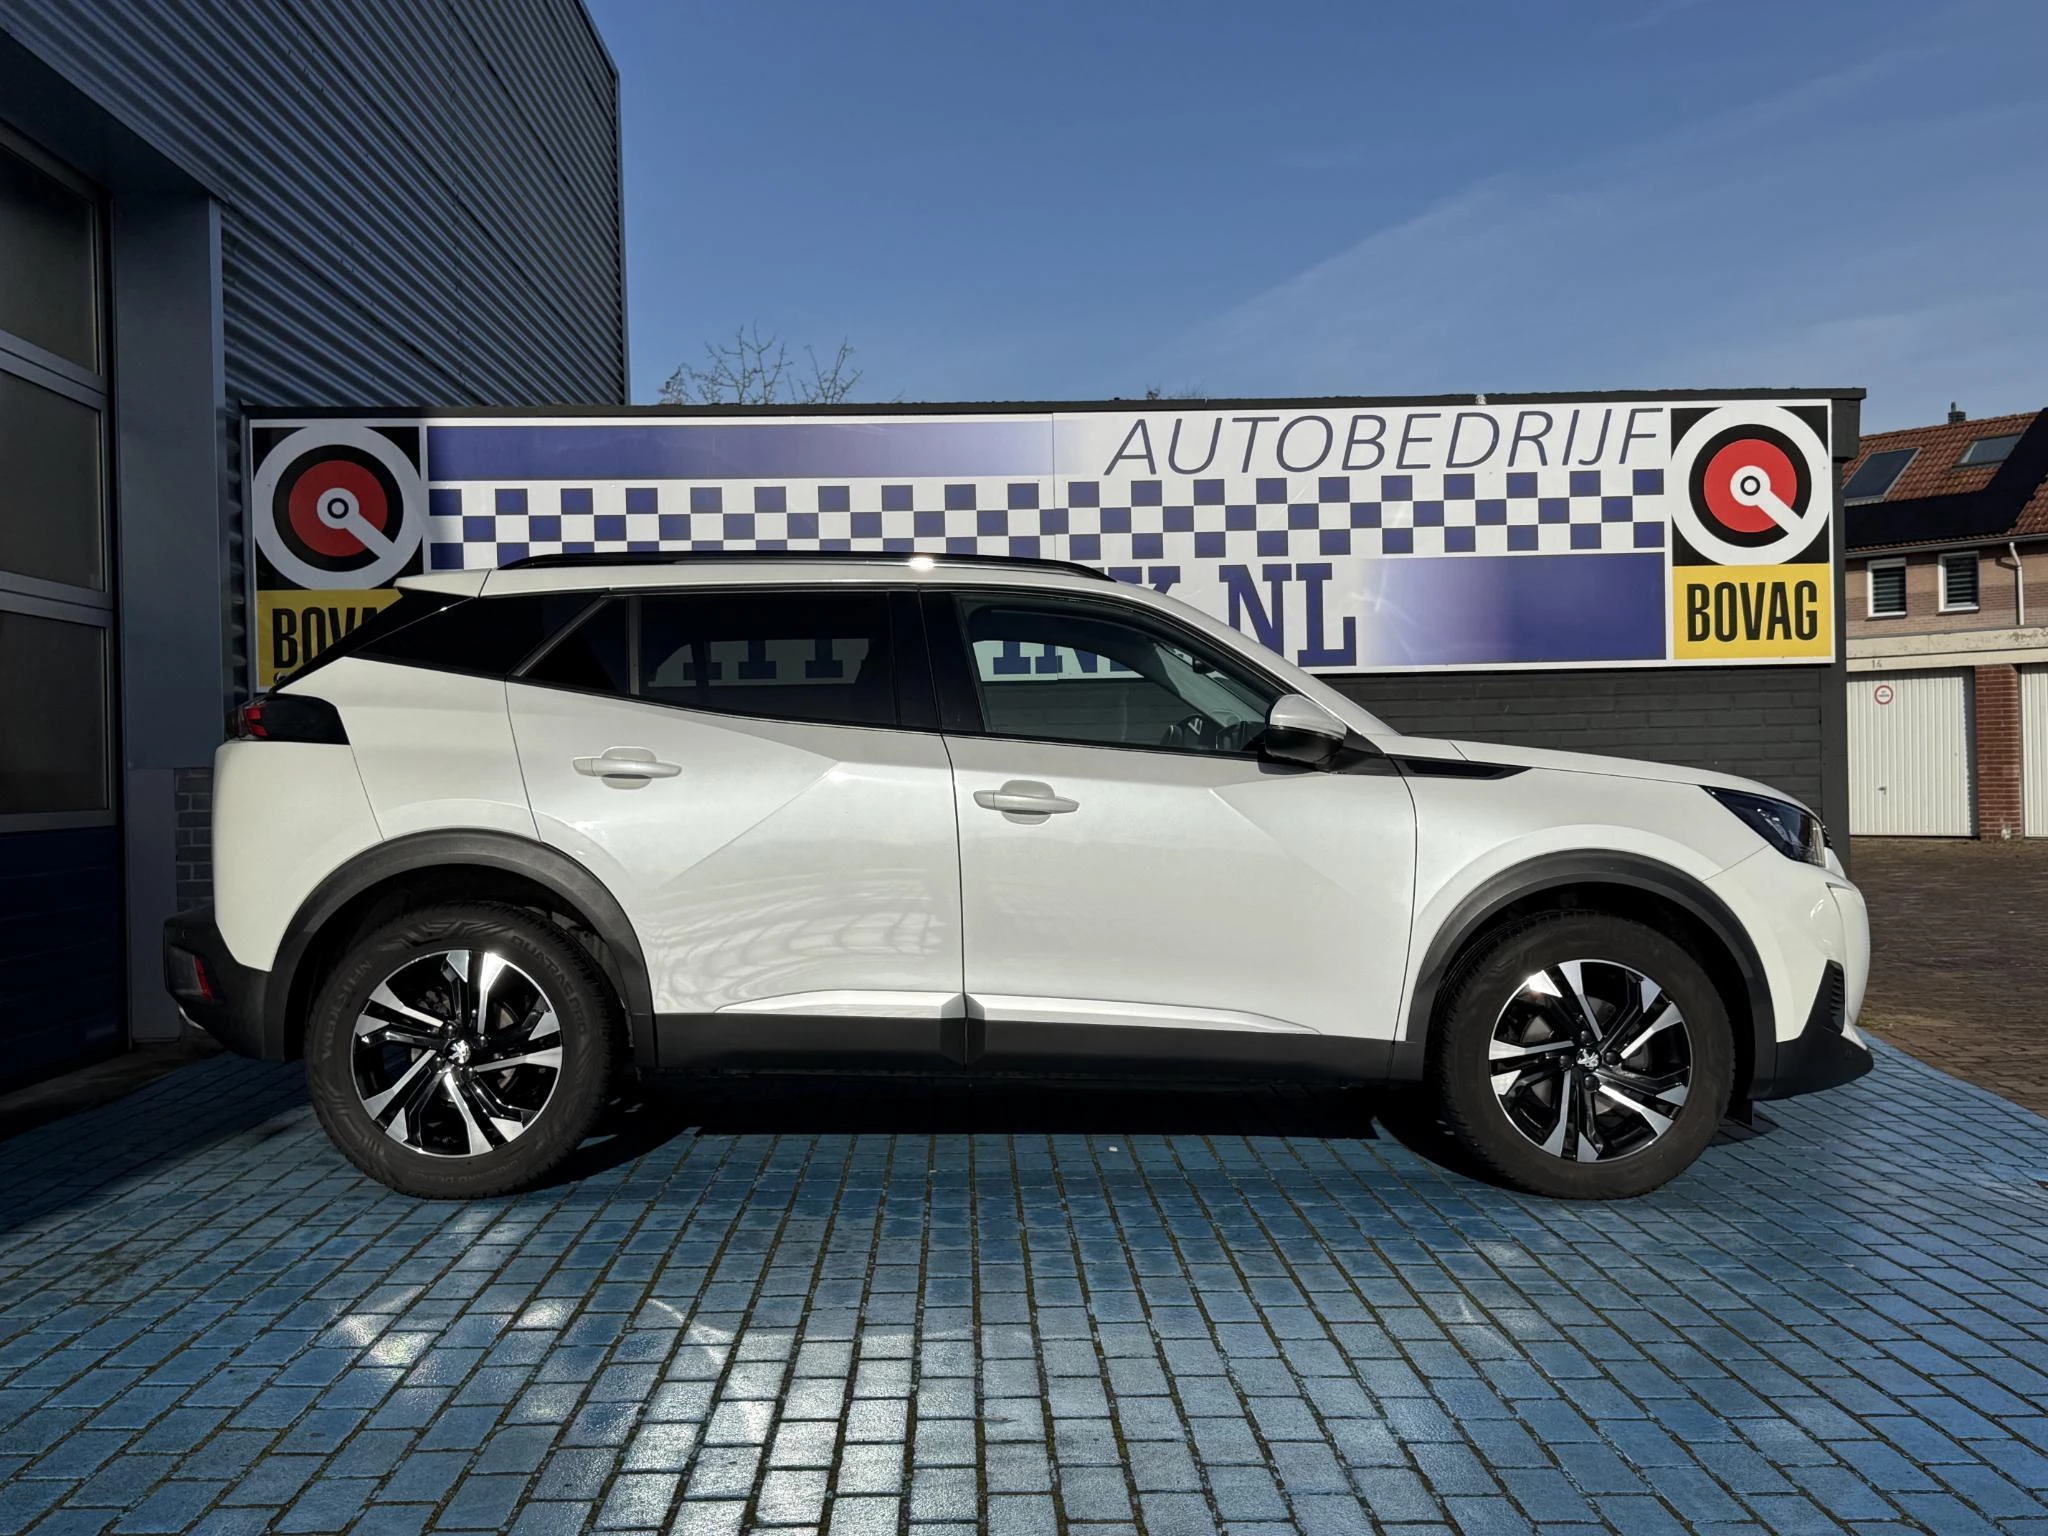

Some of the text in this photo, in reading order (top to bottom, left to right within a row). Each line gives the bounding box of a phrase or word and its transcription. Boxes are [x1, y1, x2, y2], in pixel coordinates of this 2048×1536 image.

[1103, 408, 1664, 476] AUTOBEDRIJF
[272, 606, 379, 669] BOV
[1687, 580, 1818, 642] BOVAG
